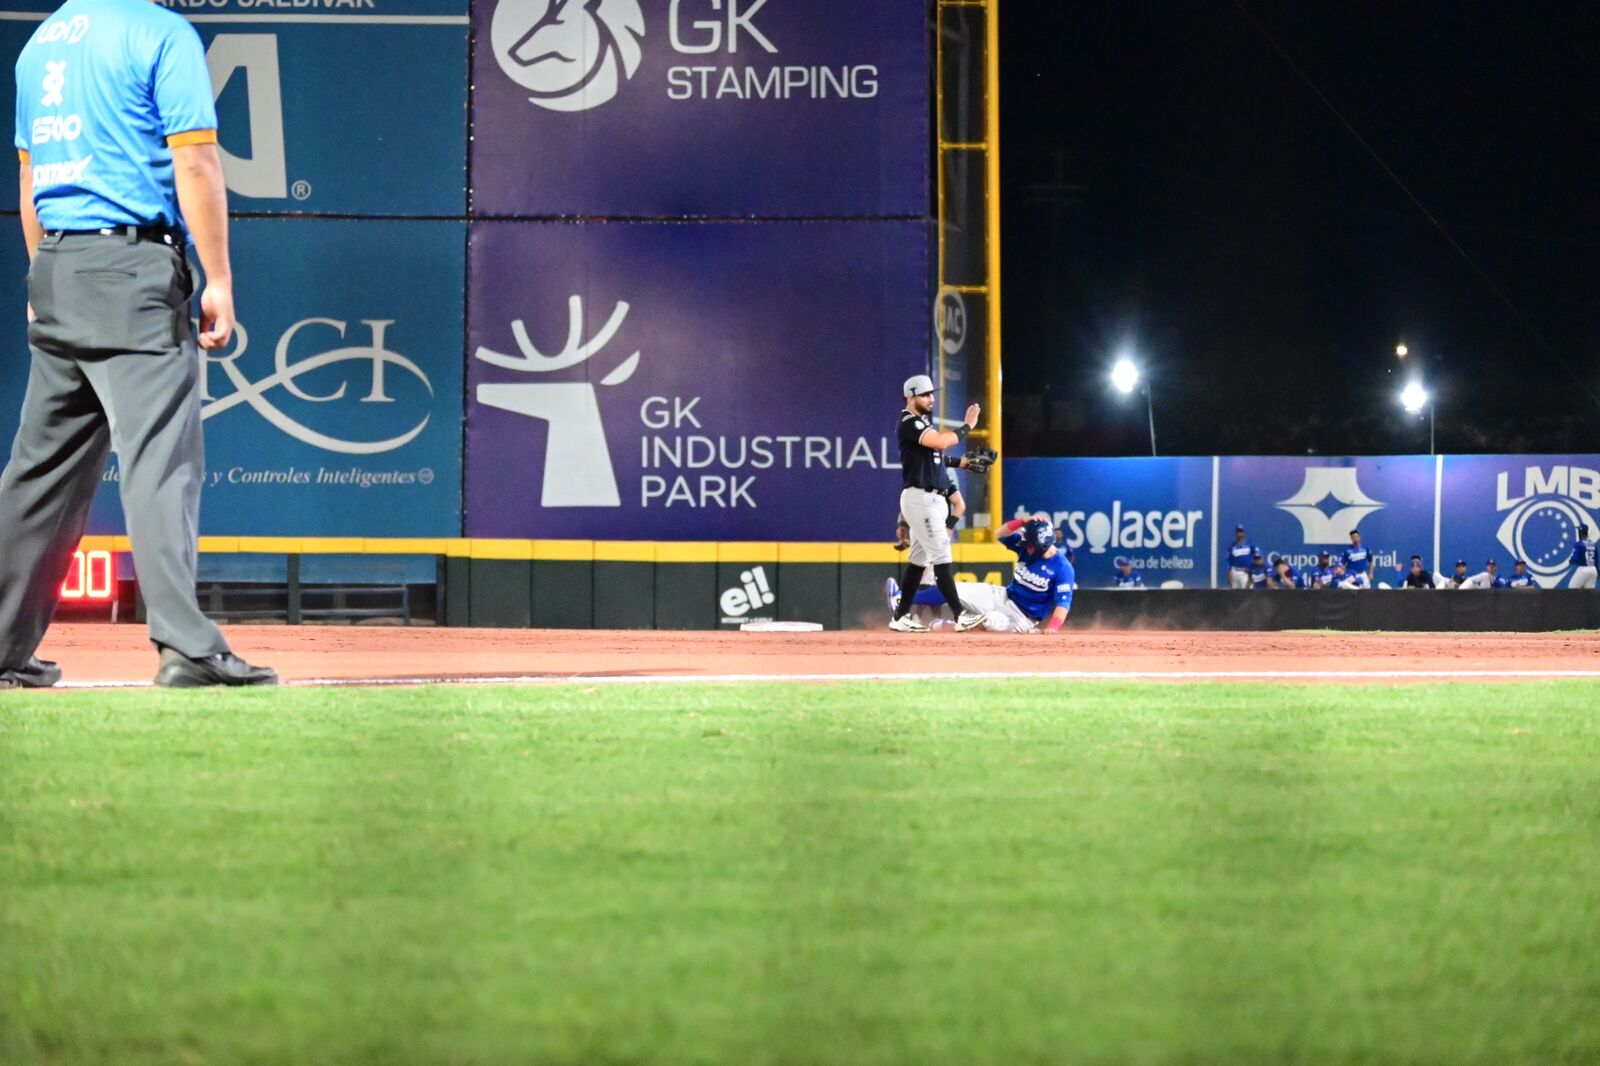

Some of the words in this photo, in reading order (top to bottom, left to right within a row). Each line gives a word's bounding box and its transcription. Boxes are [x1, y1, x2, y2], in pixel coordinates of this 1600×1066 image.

[669, 0, 779, 53] GK
[667, 65, 878, 99] STAMPING
[640, 396, 702, 429] GK
[641, 436, 904, 469] INDUSTRIAL
[210, 471, 222, 487] y
[228, 467, 310, 484] Controles
[316, 467, 416, 487] Inteligentes
[641, 475, 757, 508] PARK
[1496, 465, 1600, 512] LMB
[1146, 555, 1160, 569] de
[1160, 555, 1195, 570] belleza
